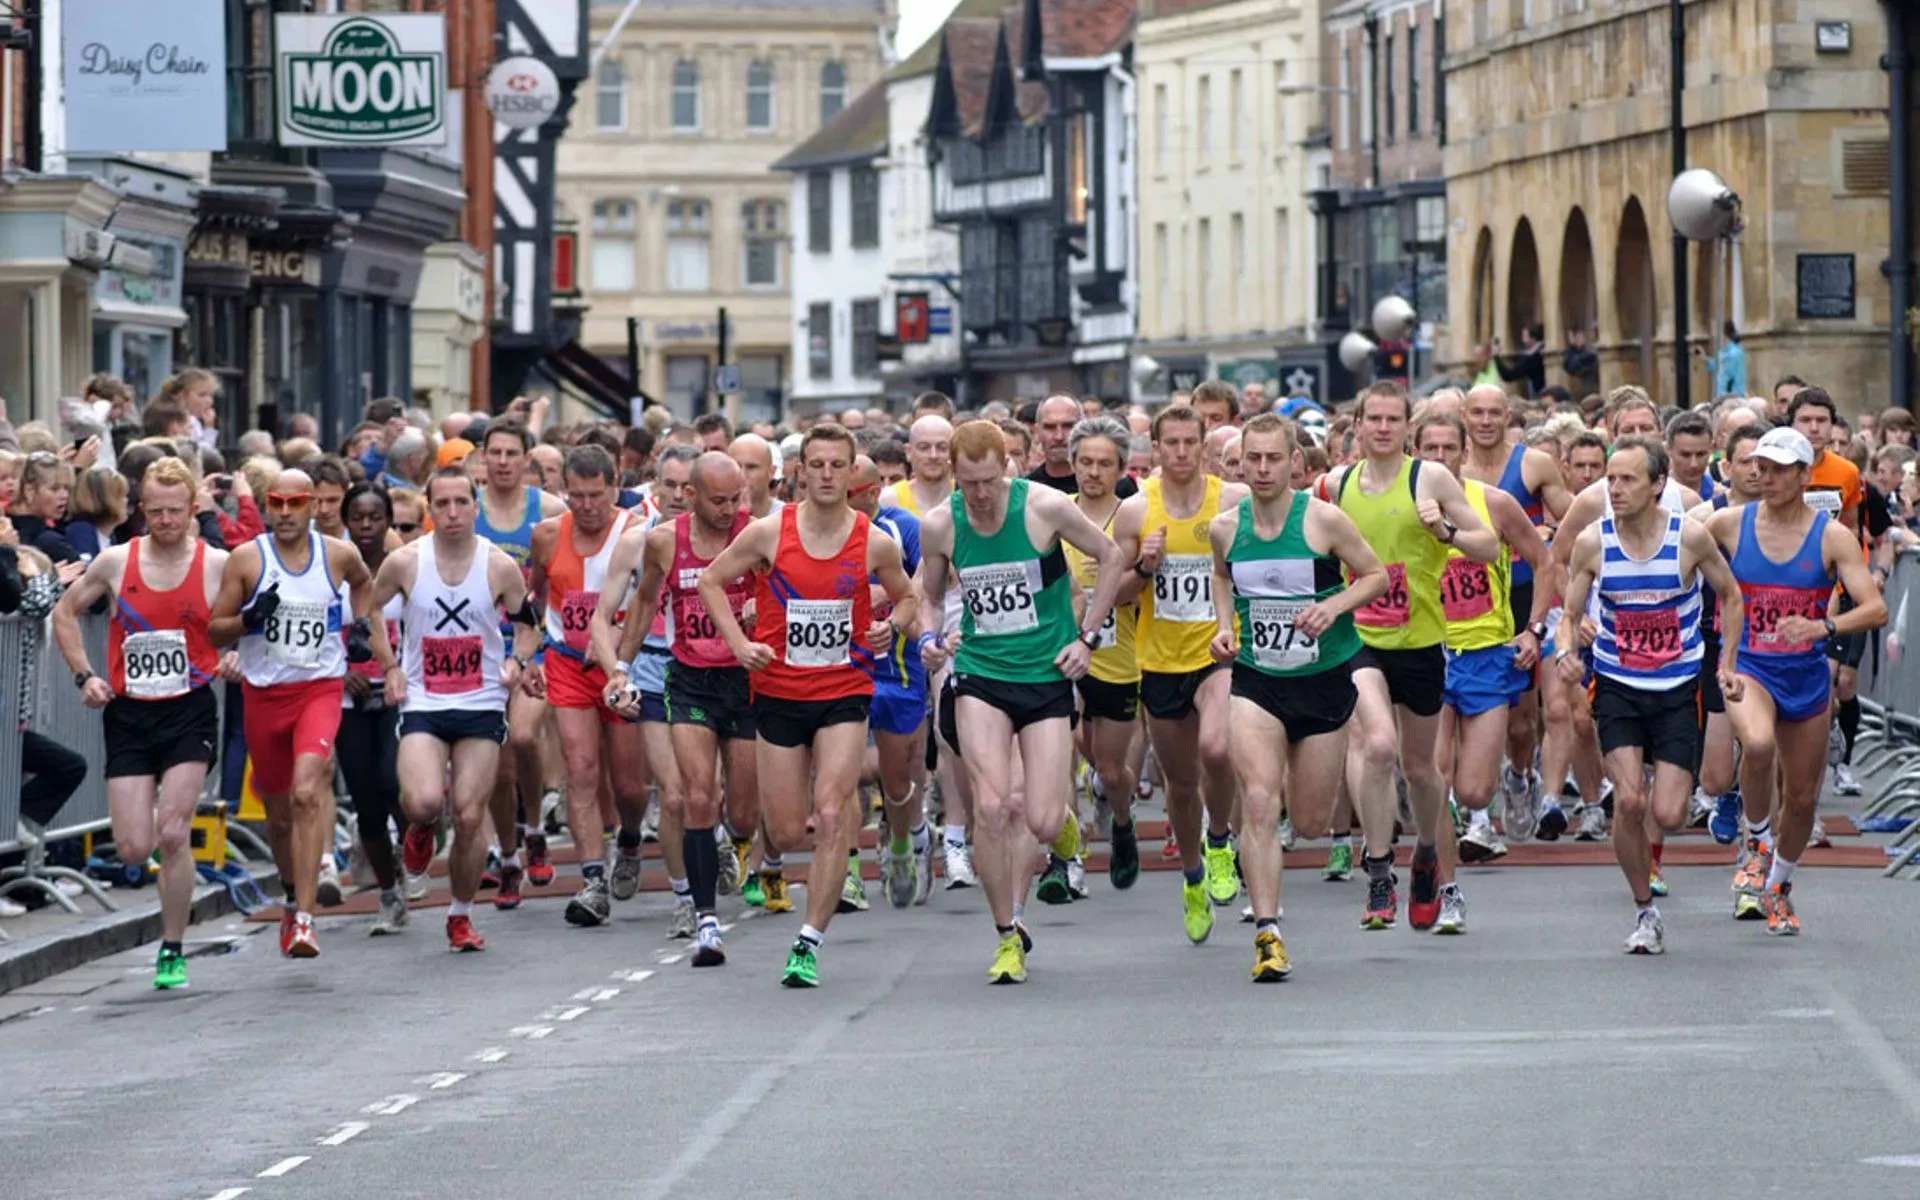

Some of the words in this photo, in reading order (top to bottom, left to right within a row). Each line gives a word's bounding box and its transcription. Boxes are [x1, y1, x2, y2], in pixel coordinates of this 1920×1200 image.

[78, 42, 143, 85] Daisy
[146, 42, 209, 75] Chain
[293, 60, 432, 113] MOON
[493, 93, 554, 114] HSBC
[968, 582, 1032, 616] 8365
[1155, 575, 1210, 602] 8191
[265, 616, 325, 649] 8159
[789, 621, 850, 649] 8035
[1617, 626, 1680, 653] 3202
[127, 650, 186, 679] 8900
[424, 650, 481, 677] 3449
